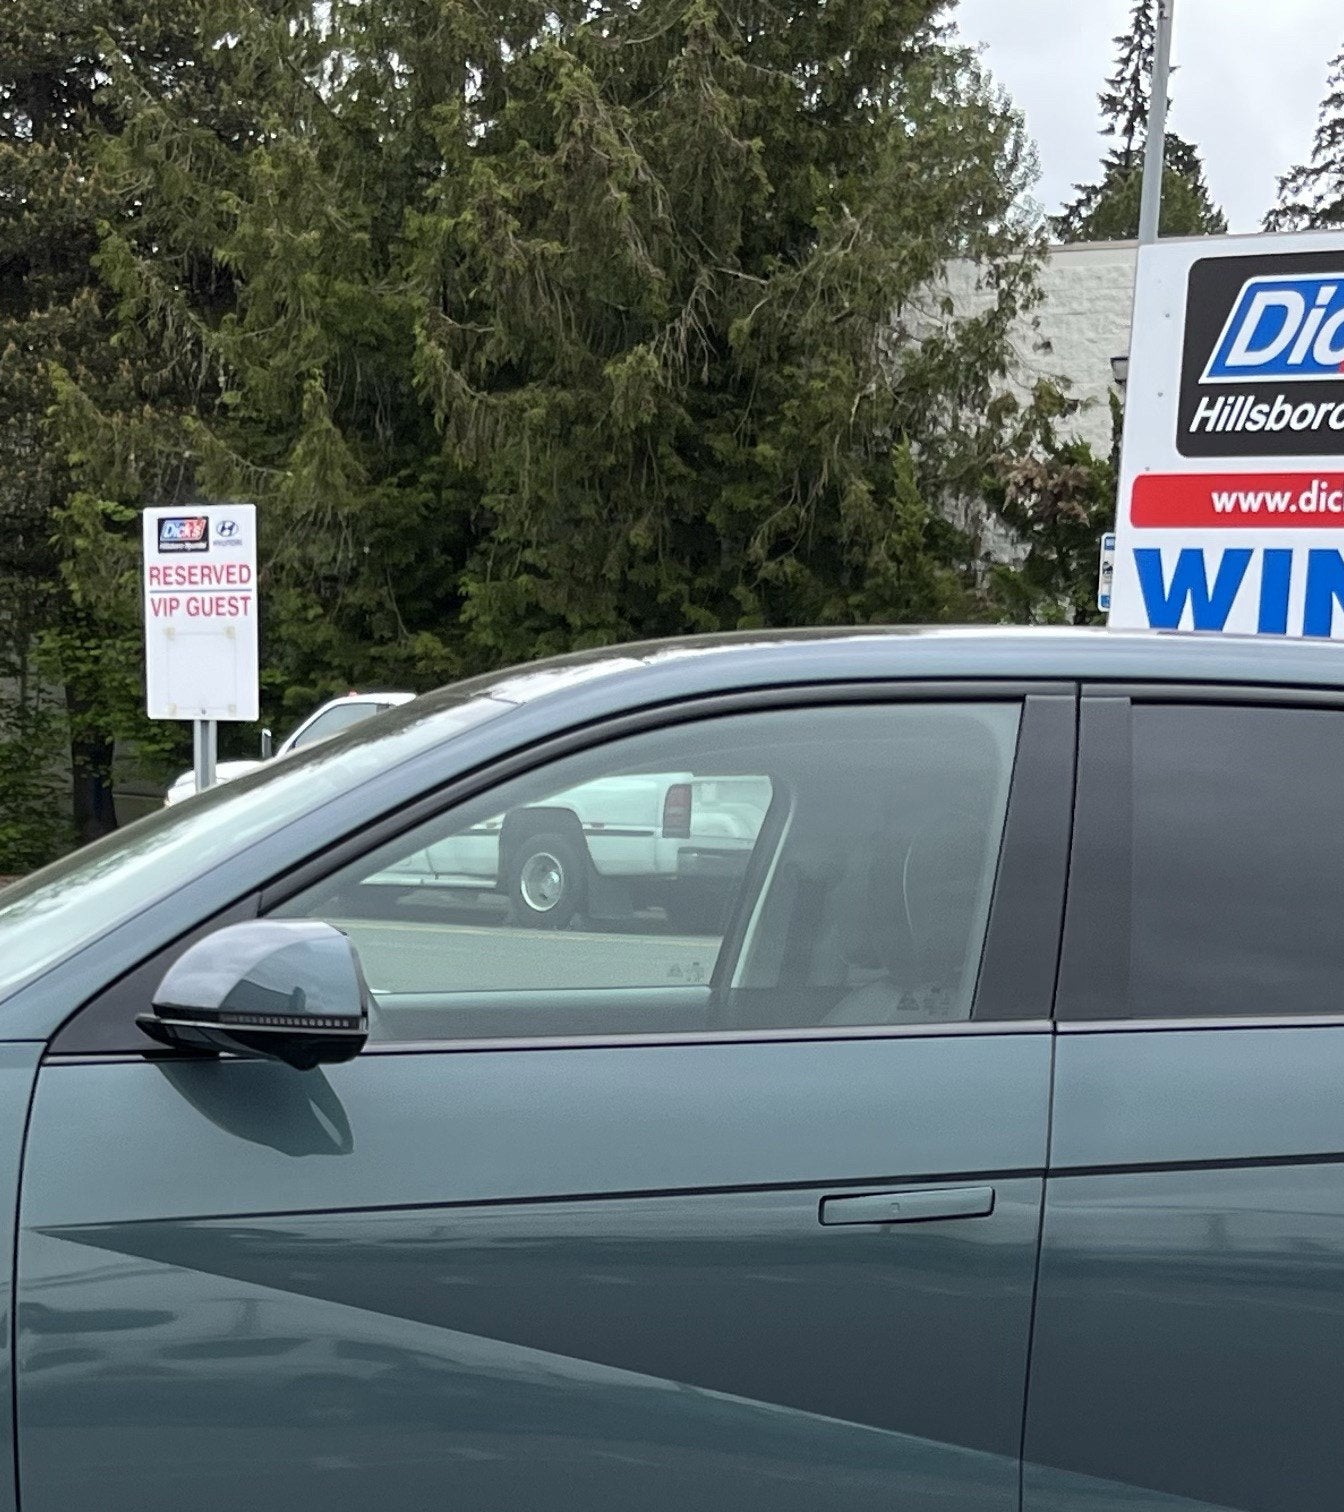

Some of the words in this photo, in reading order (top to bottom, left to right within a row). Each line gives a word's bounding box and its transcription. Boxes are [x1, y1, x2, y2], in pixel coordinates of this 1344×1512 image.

[148, 564, 252, 587] RESERVED
[150, 597, 180, 618] VIP
[186, 596, 252, 618] GUEST
